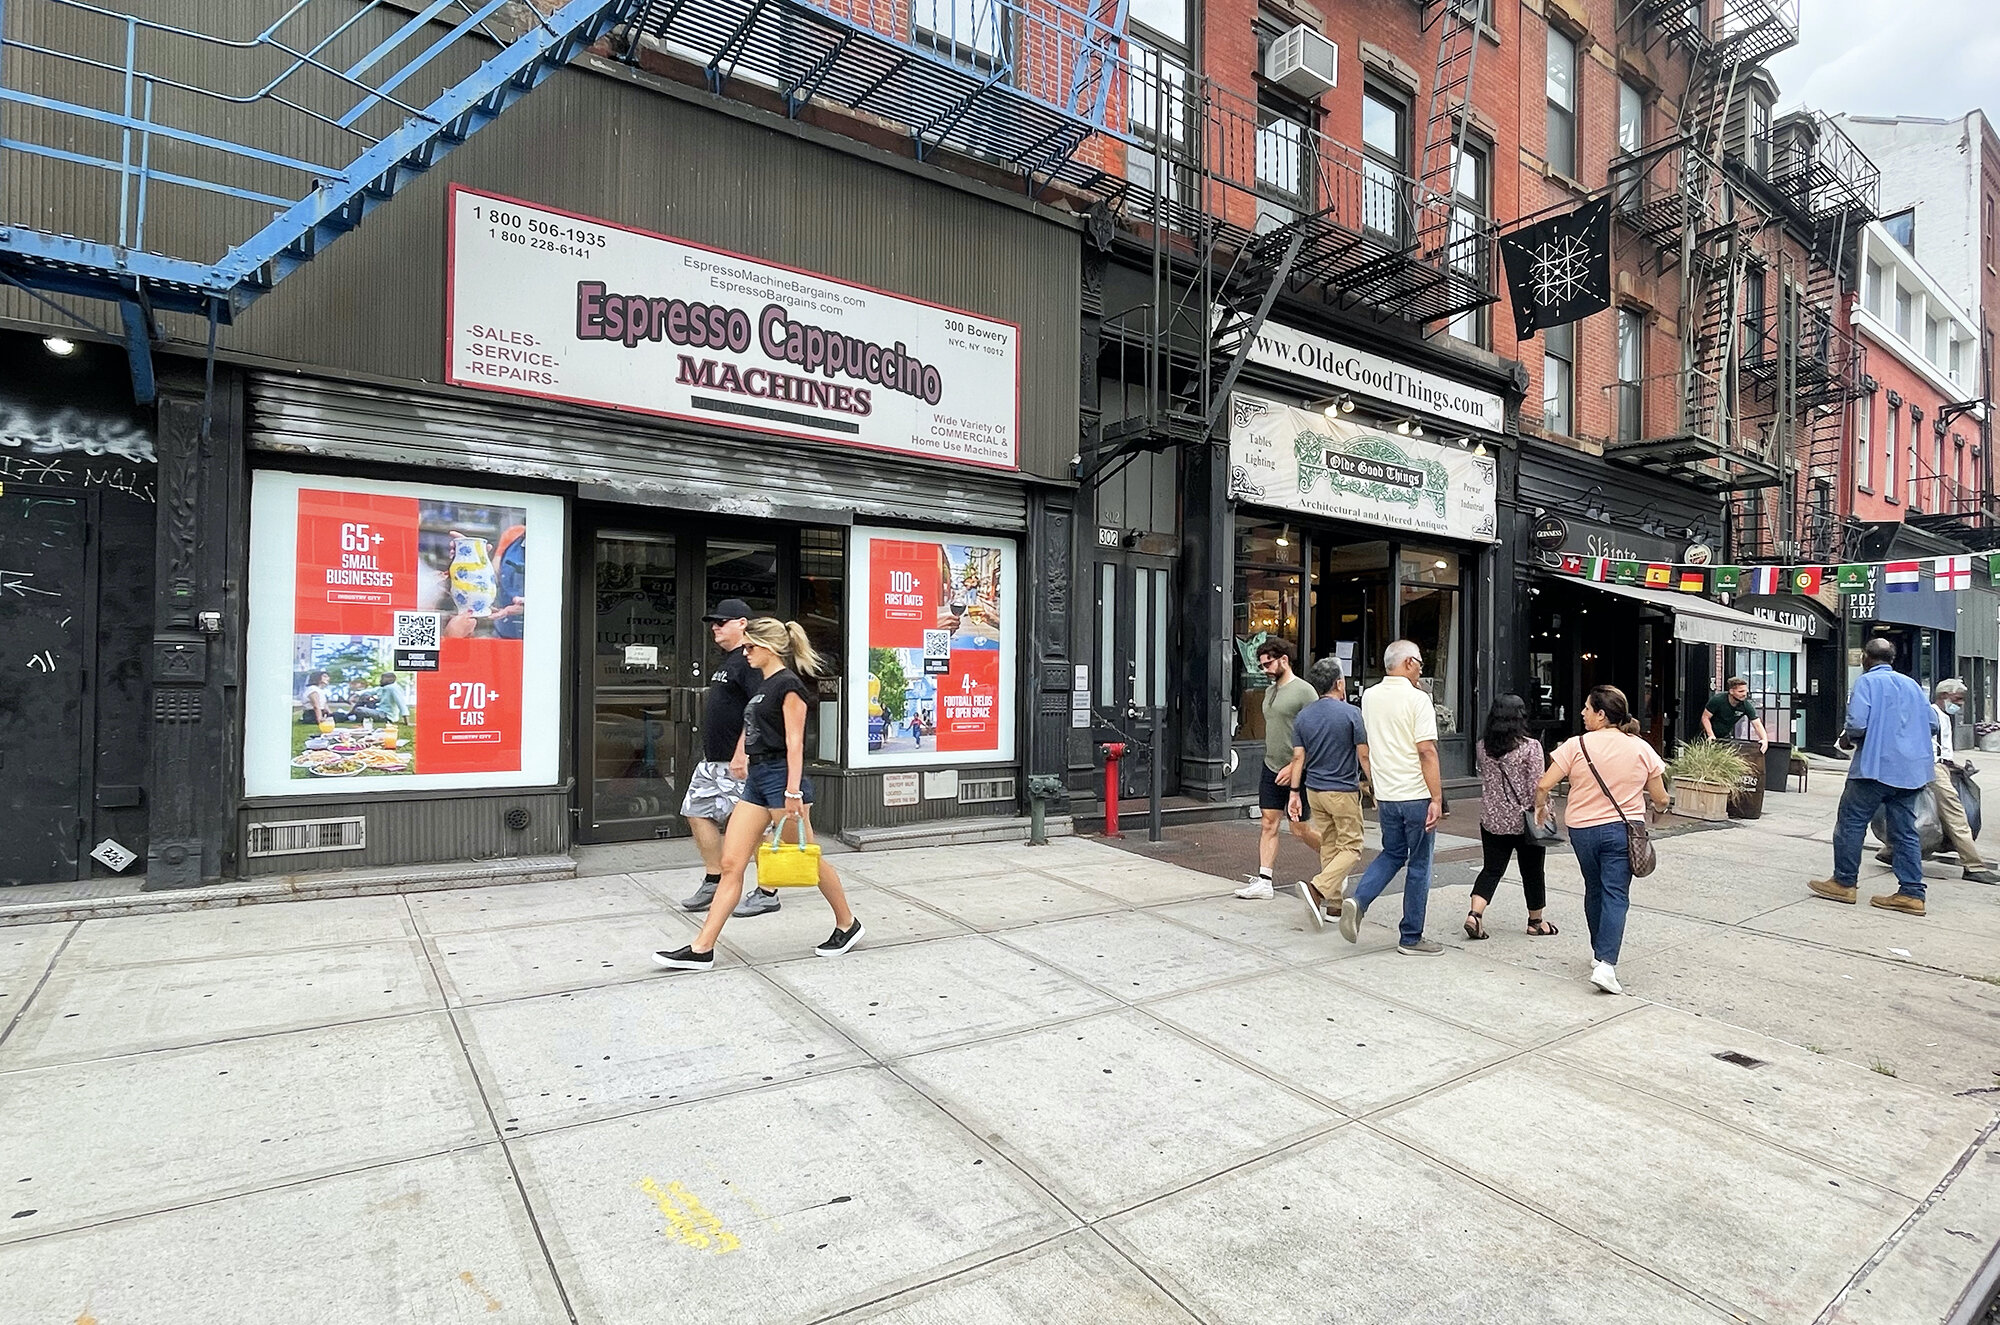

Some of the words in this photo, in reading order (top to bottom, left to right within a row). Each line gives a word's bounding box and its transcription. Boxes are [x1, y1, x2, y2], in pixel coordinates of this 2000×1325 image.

[474, 206, 481, 219] 1
[489, 210, 521, 229] 800
[528, 219, 606, 248] 506-1935
[489, 228, 495, 238] 1
[501, 231, 526, 245] 800
[530, 237, 590, 259] 228-6141
[683, 255, 866, 308] EspressoMachineBargains.com
[710, 276, 844, 316] EspressoBargains.com
[466, 324, 541, 347] -SALES-
[576, 280, 751, 353] Espresso
[759, 303, 942, 406] Cappuccino
[944, 319, 964, 333] 300
[967, 324, 1008, 345] Bowery
[465, 343, 560, 368] -SERVICE-
[948, 338, 967, 350] NYC,
[969, 343, 980, 351] NY
[983, 346, 1004, 357] 10012
[465, 361, 559, 385] -REPAIRS-
[1238, 329, 1485, 418] ww.OldeGoodThings.com
[675, 353, 872, 417] MACHINES
[933, 413, 957, 426] Wide
[960, 418, 993, 434] Variety
[995, 424, 1006, 435] Of
[911, 434, 940, 448] Home
[943, 440, 961, 452] Use
[964, 443, 1008, 459] Machines
[930, 425, 999, 446] COMMERCIAL
[1001, 438, 1008, 447] &
[1249, 432, 1273, 448] Tables
[1245, 452, 1276, 471] Lighting
[1329, 455, 1355, 472] Olde
[1357, 459, 1384, 478] Good
[1386, 467, 1420, 486] Things
[1299, 499, 1361, 517] Architectural
[1363, 511, 1379, 521] and
[1382, 513, 1412, 526] Altered
[1414, 519, 1449, 531] Antiques
[341, 522, 385, 552] 65+
[1100, 529, 1118, 546] 302
[341, 553, 379, 570] SMALL
[326, 568, 393, 587] BUSINESSES
[889, 570, 920, 594] 100+
[884, 592, 903, 605] FIRST
[903, 594, 924, 606] DATES
[1850, 593, 1876, 606] POE
[1779, 611, 1807, 632] STAND
[1850, 605, 1875, 619] TRY
[961, 673, 978, 695] 4+
[448, 682, 500, 710] 270+
[943, 695, 972, 707] FOOTBALL
[973, 695, 993, 707] FIELDS
[460, 711, 485, 726] EATS
[946, 707, 954, 719] OF
[955, 707, 971, 719] OPEN
[972, 707, 990, 718] SPACE
